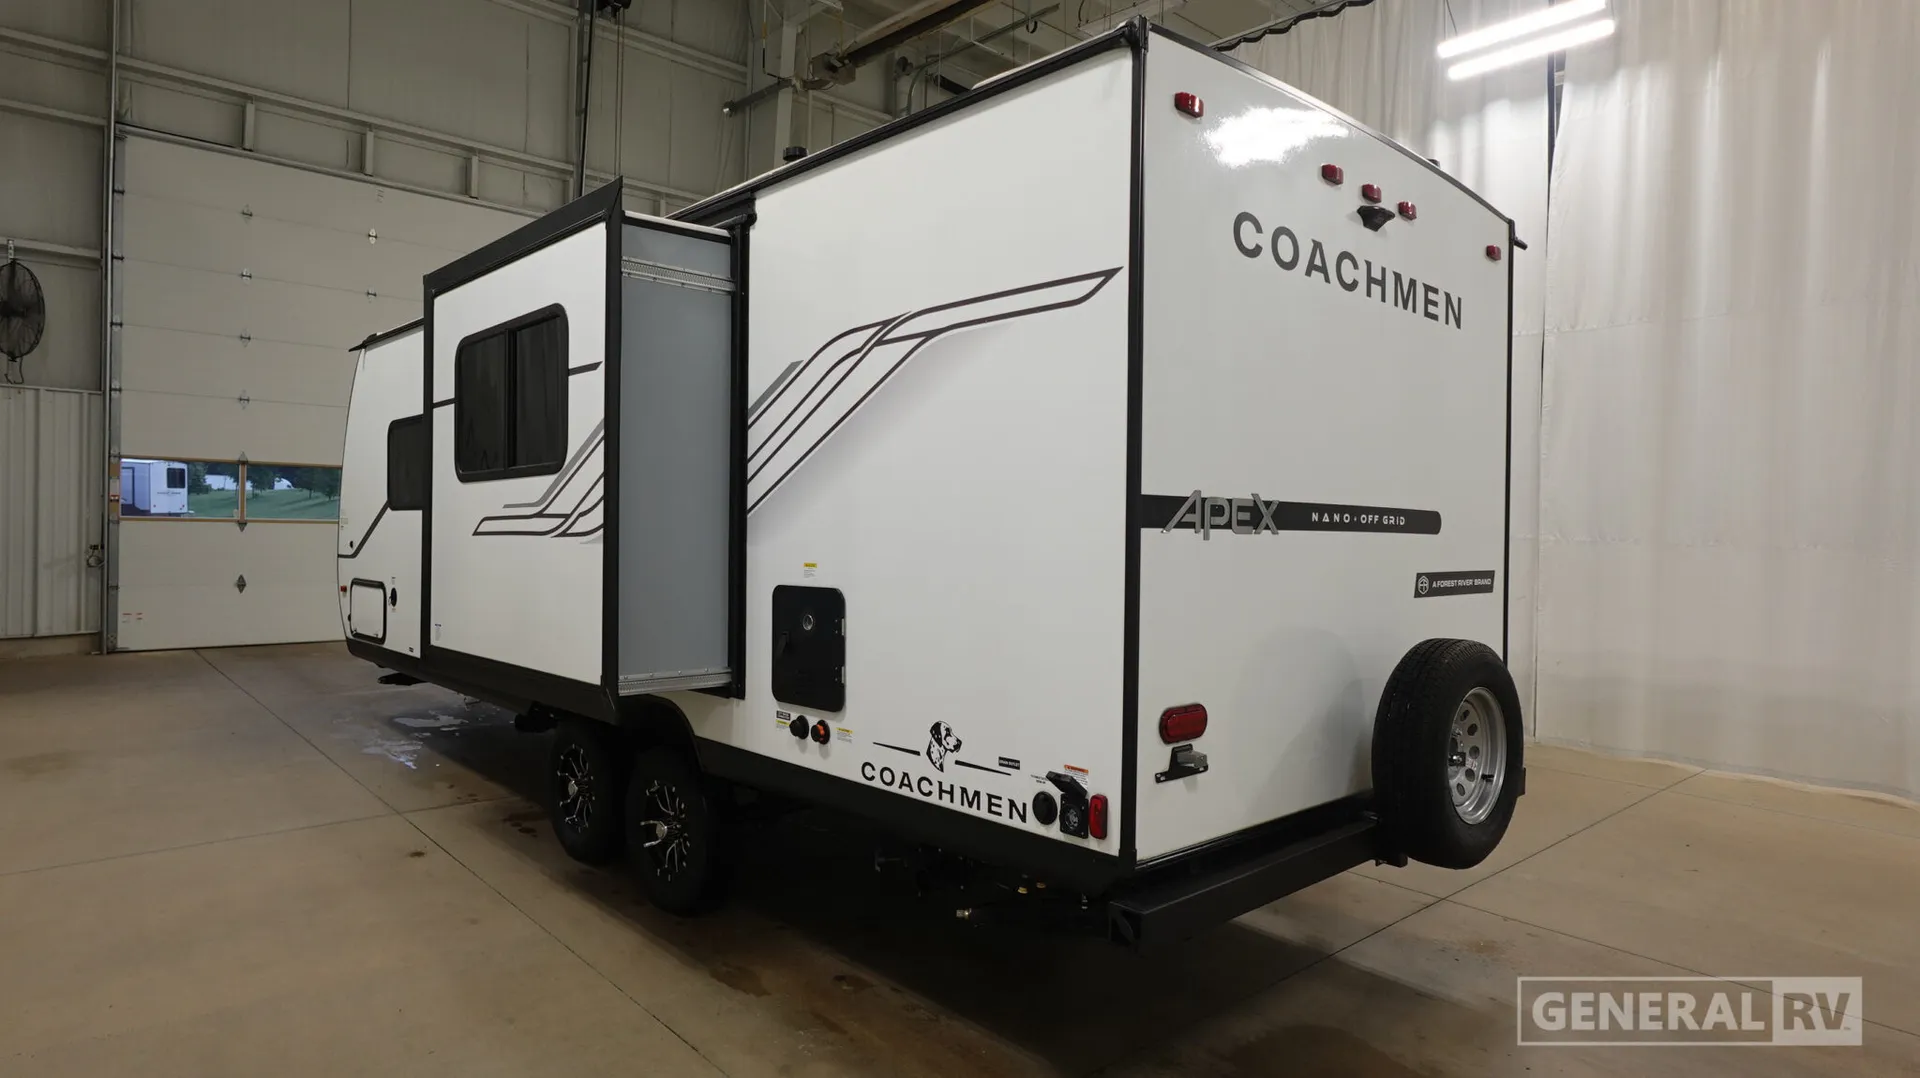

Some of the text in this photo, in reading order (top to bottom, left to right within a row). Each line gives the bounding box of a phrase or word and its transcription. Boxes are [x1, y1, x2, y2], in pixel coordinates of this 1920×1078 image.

[1233, 211, 1462, 330] COACHMEN
[1160, 489, 1279, 541] APEX
[1311, 512, 1406, 526] NANO OFF GRID
[1437, 580, 1457, 588] FOREST
[1458, 579, 1473, 587] RIVER
[1474, 578, 1492, 586] BRAND
[861, 761, 1027, 824] COACHMEN
